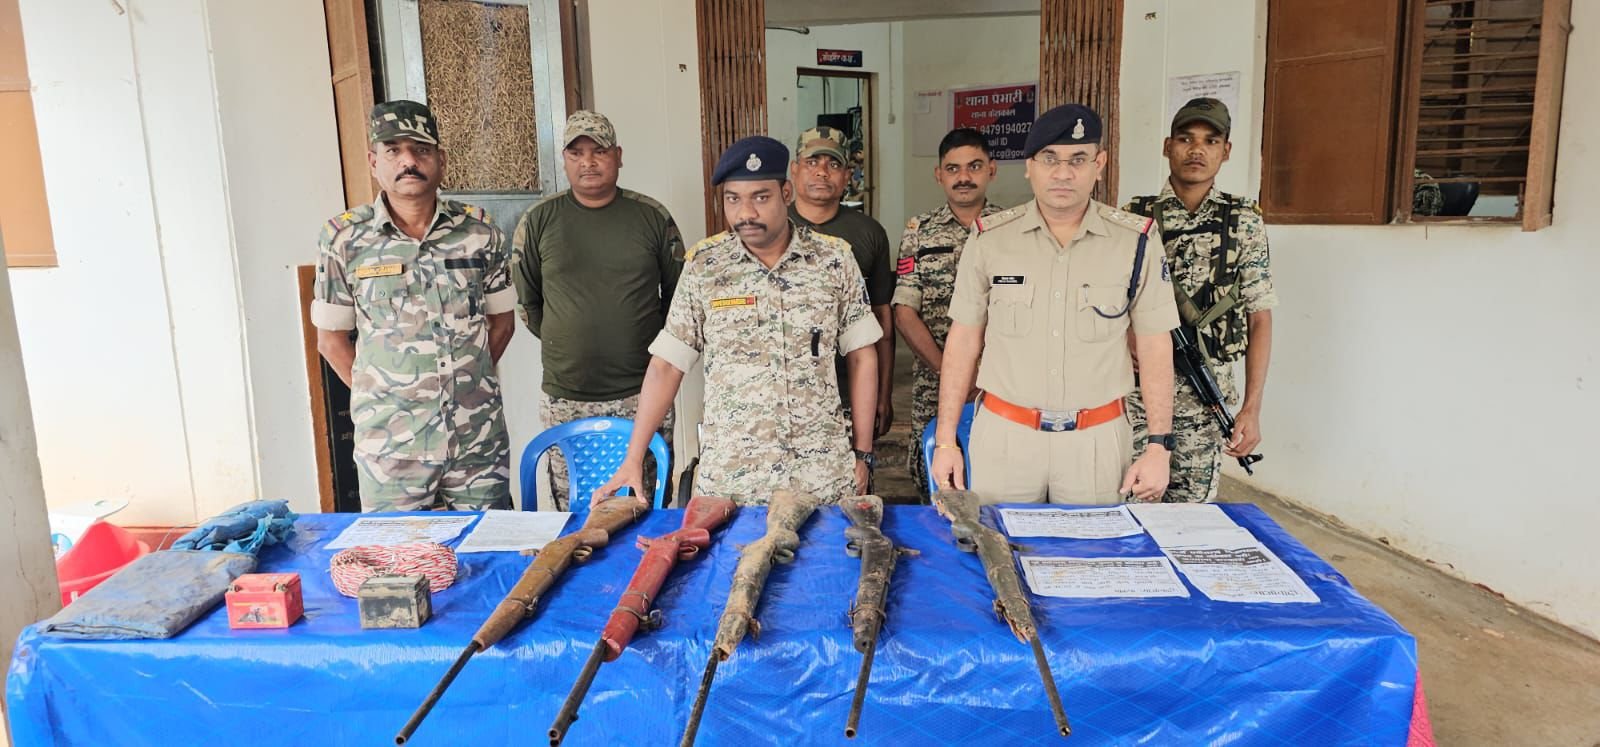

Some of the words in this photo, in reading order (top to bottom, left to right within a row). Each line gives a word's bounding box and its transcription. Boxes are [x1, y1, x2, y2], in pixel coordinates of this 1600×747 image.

[966, 95, 988, 106] थाना
[992, 89, 1022, 104] प्रभारी
[980, 122, 1032, 135] 9479194027
[1000, 137, 1008, 145] ID
